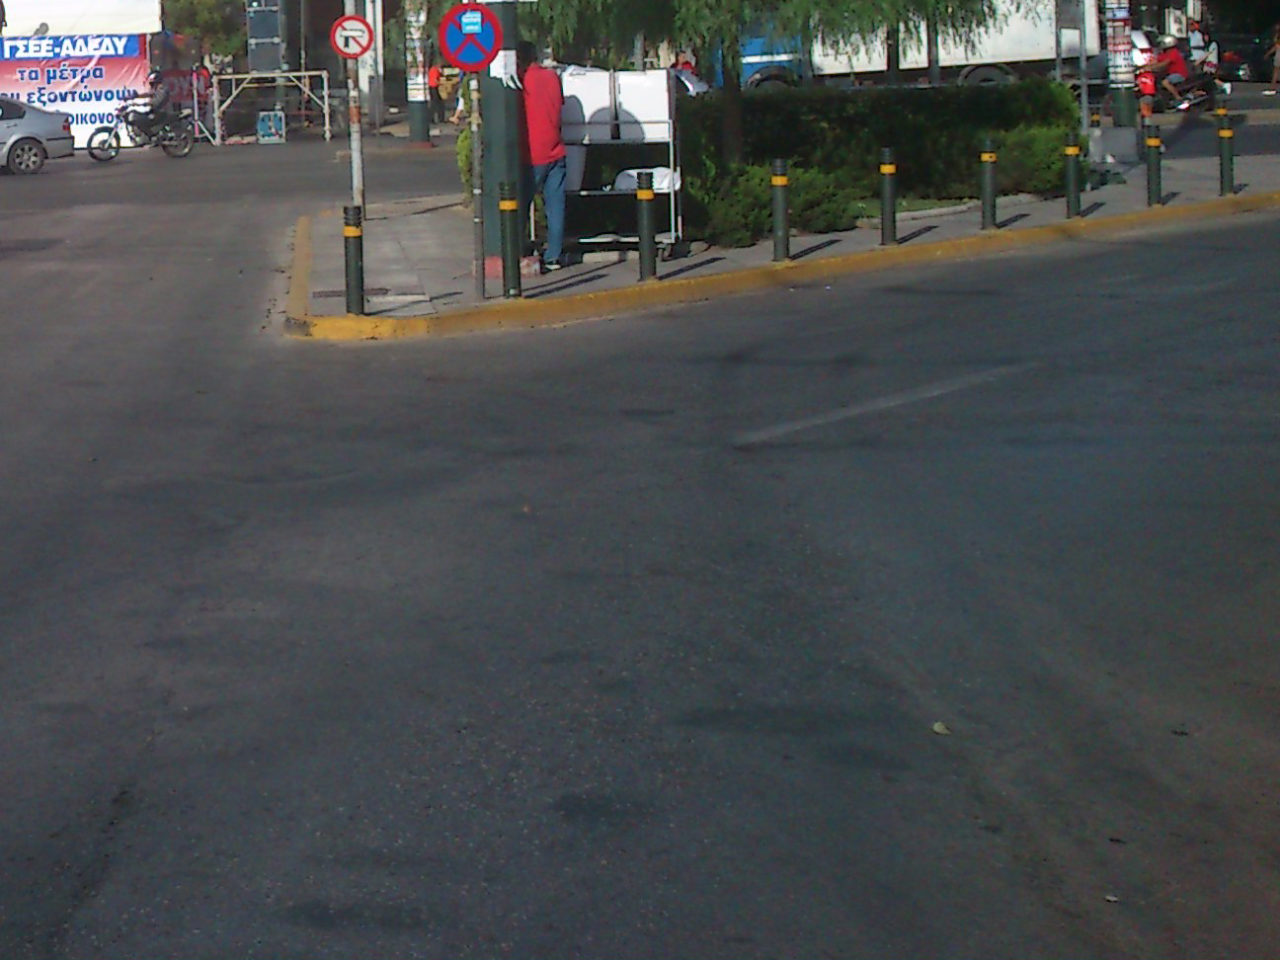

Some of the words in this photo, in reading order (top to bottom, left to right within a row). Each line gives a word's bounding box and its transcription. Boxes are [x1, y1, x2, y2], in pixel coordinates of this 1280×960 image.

[3, 36, 129, 59] ΓΣΕΕ-ΑΔΕΔΥ
[18, 68, 40, 82] τα
[45, 64, 104, 84] μέτρα
